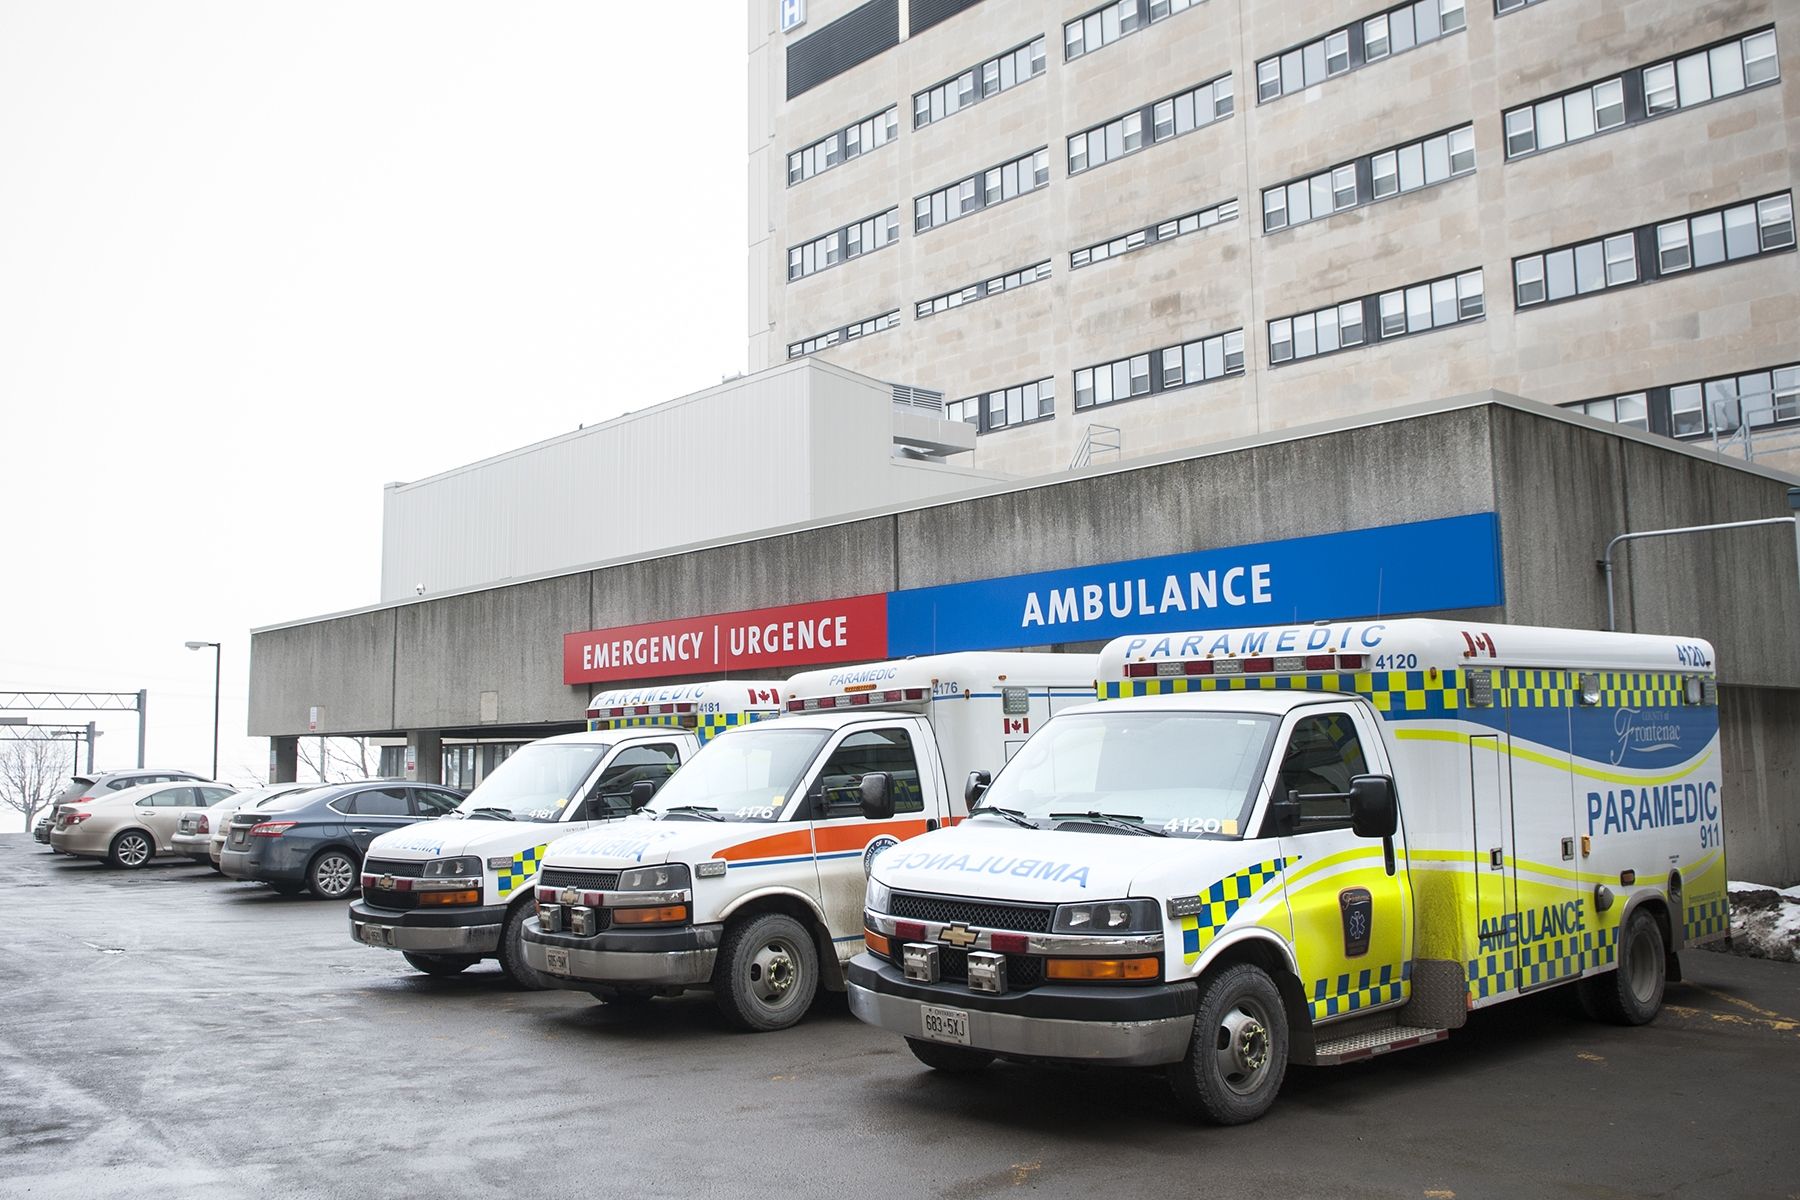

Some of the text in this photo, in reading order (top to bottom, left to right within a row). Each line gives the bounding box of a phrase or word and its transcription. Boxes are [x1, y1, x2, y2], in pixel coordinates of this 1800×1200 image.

[1021, 563, 1272, 627] AMBULANCE
[583, 616, 848, 670] EMERGENCY URGENCE
[1125, 624, 1386, 658] PARAMEDIC
[1375, 653, 1418, 670] 4120
[1675, 644, 1706, 667] 4120
[829, 667, 898, 686] PARAMEDIC
[594, 685, 708, 706] PARAMEDIC
[932, 681, 958, 695] 4176
[699, 702, 720, 712] 4181
[1610, 707, 1681, 766] Frontenac
[527, 808, 554, 820] 4181
[735, 806, 774, 819] 4176
[1587, 781, 1718, 836] PARAMEDIC
[1163, 817, 1220, 833] 4120
[1700, 823, 1720, 849] 911
[1478, 899, 1585, 956] AMBULANCE
